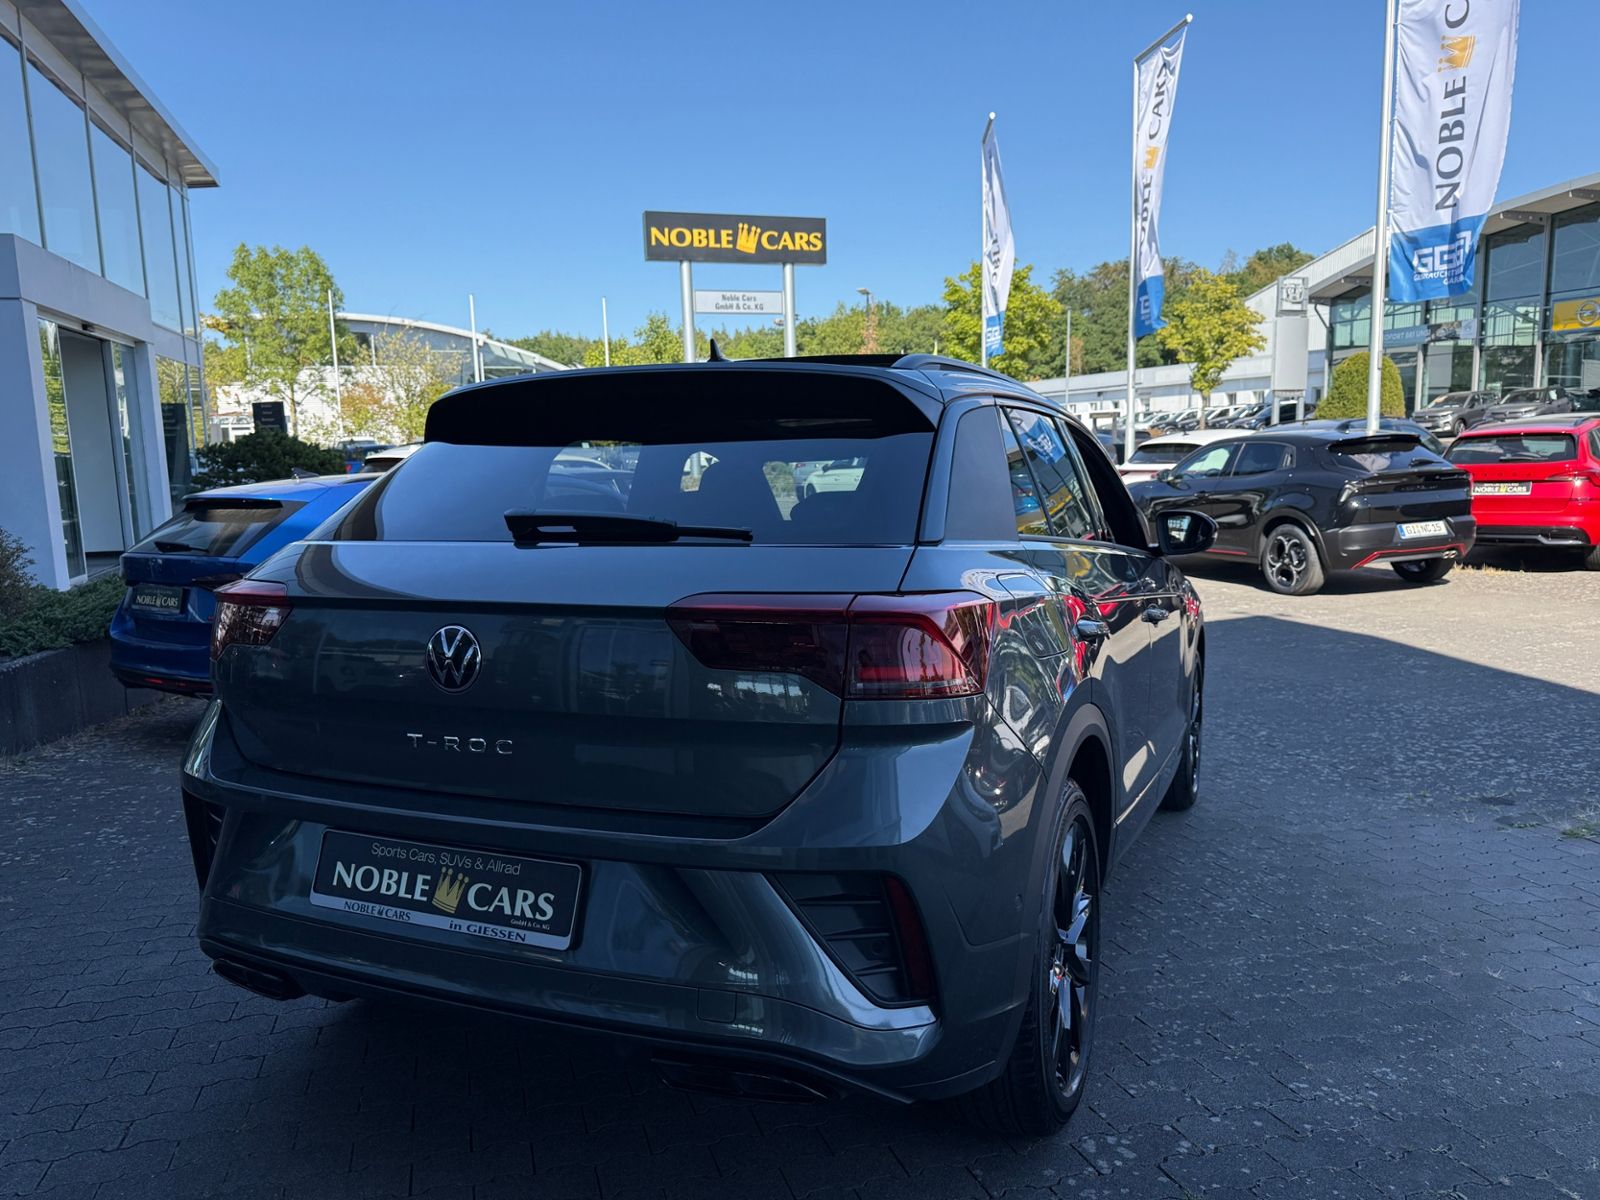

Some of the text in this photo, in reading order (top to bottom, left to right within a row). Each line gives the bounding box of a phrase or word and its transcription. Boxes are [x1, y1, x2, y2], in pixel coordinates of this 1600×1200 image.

[1435, 75, 1467, 212] NOBLE
[650, 226, 823, 251] NOBLE CARS
[741, 294, 757, 302] Cars
[136, 595, 178, 607] NOBLE CARS
[407, 733, 513, 755] T-ROC
[371, 842, 521, 876] Sports Cars, SUVs & Allrad
[332, 861, 555, 921] NOBLE CARS
[344, 901, 411, 922] NOBLE CARS
[449, 920, 527, 943] in GIESSEN
